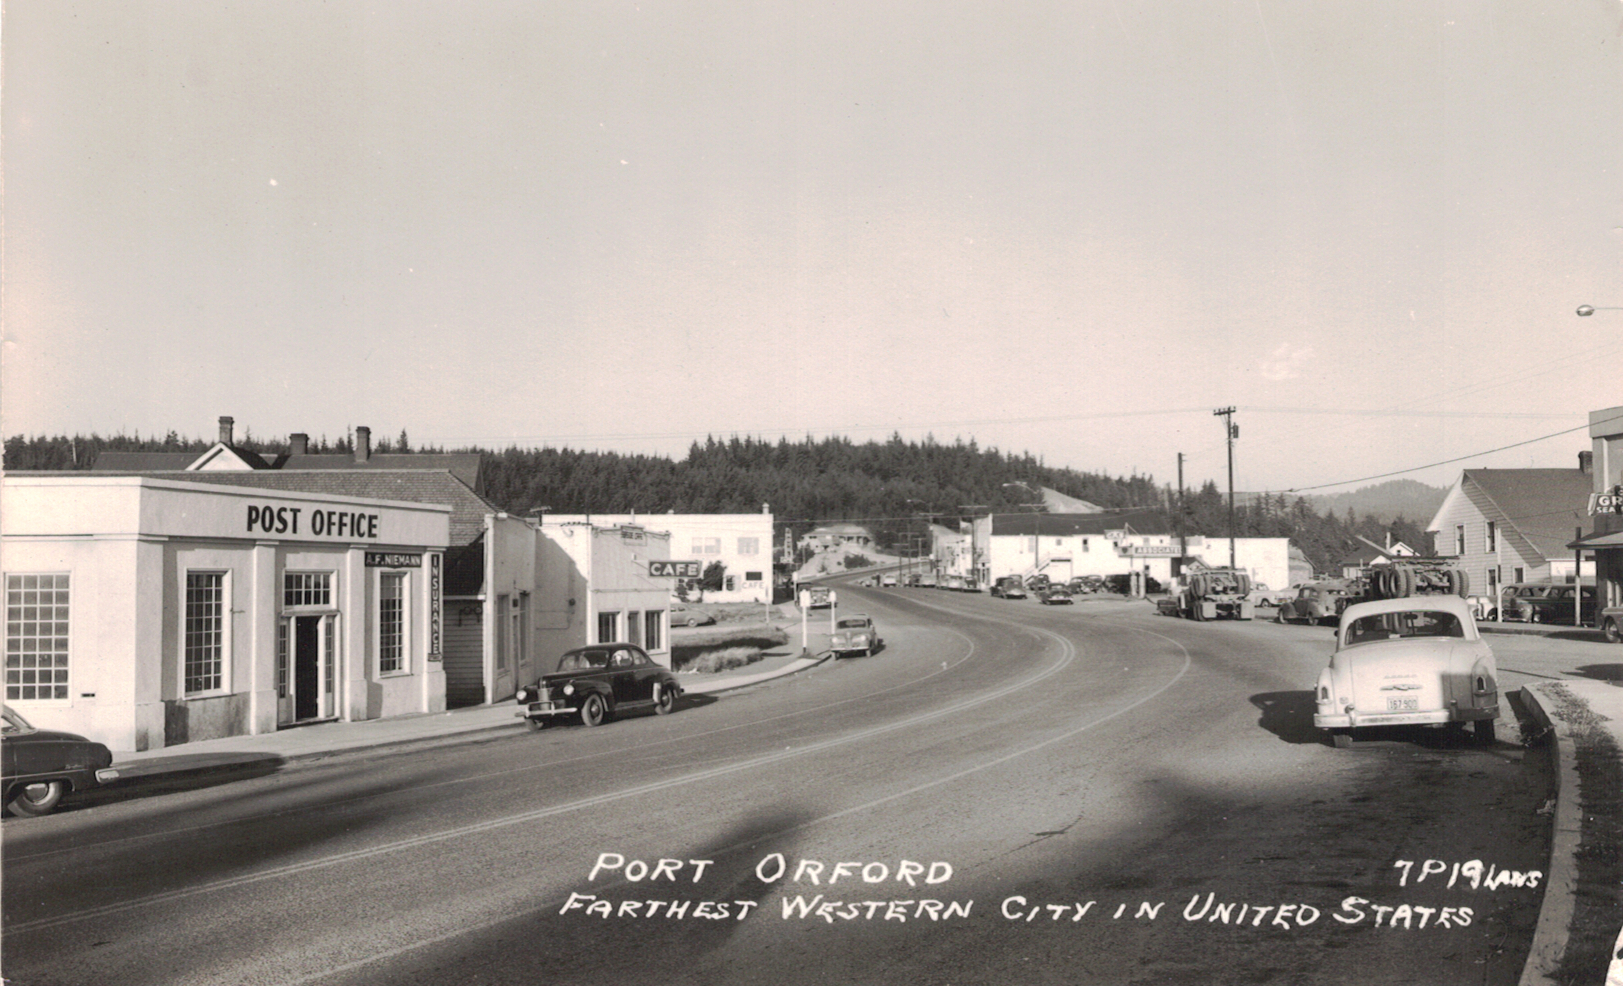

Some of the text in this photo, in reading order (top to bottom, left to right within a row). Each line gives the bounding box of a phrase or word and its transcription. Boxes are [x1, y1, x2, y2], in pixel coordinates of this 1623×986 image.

[246, 505, 378, 538] POST OFFICE
[650, 563, 698, 576] CAFE
[741, 581, 765, 590] CAFE
[431, 556, 439, 654] INSURANCE
